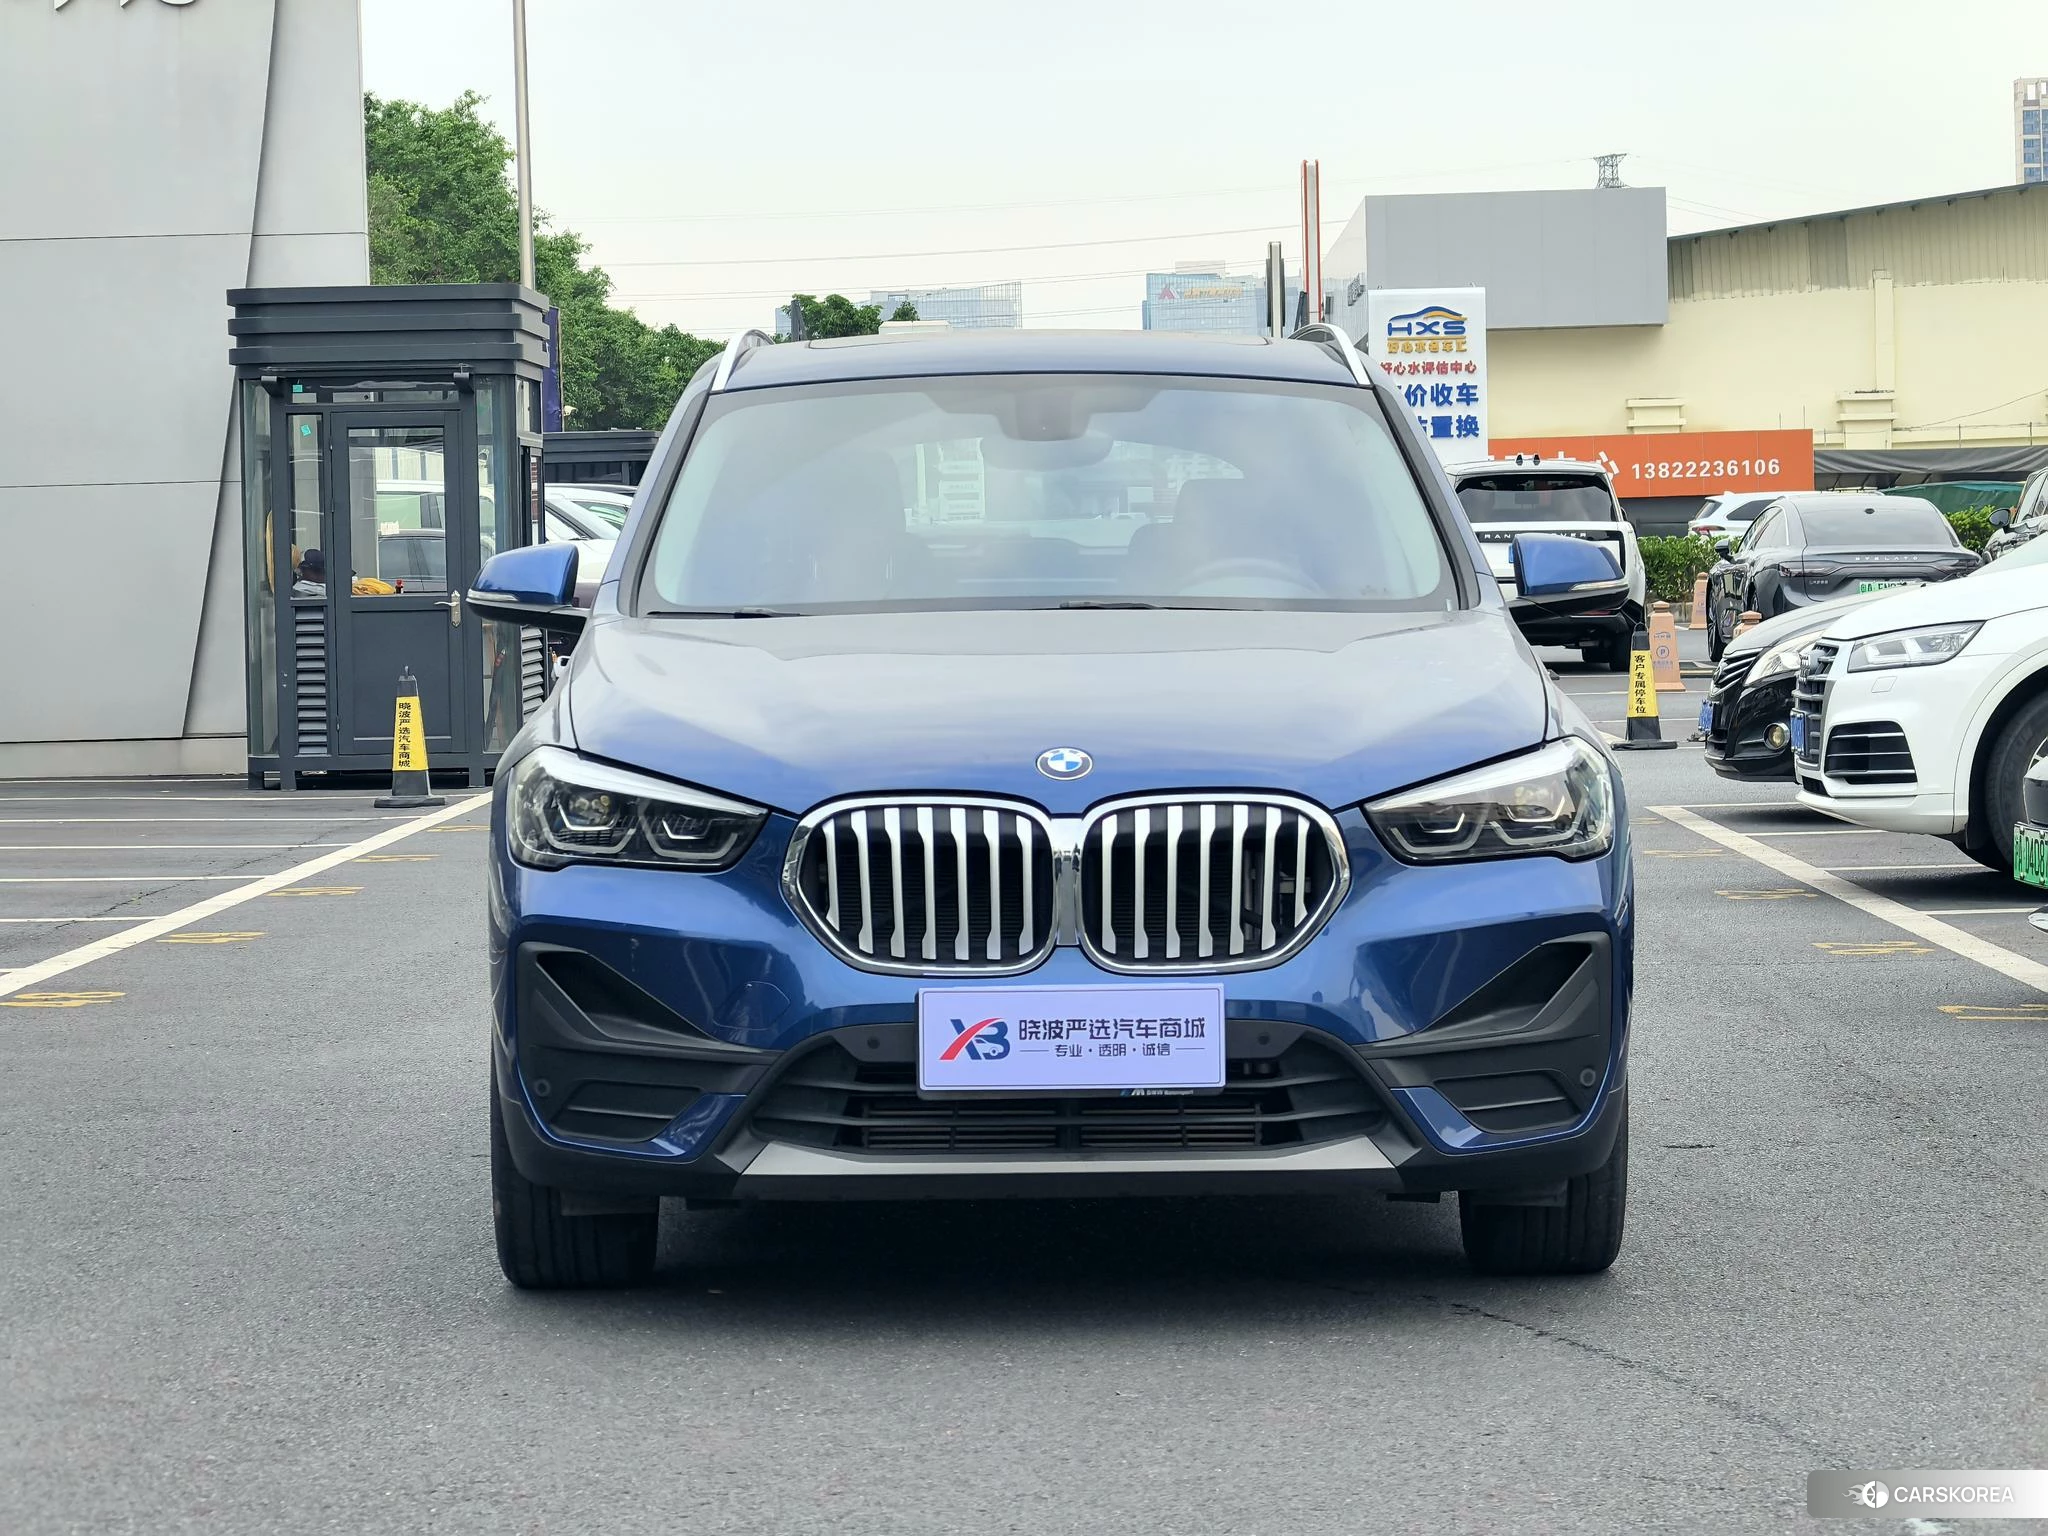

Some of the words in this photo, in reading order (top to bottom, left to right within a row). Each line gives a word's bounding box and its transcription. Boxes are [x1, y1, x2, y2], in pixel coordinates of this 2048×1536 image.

[1387, 320, 1466, 336] HXS
[1397, 383, 1479, 407] 价收车
[1631, 458, 1781, 480] 13822236106
[1634, 654, 1647, 714] 客户专属停车位
[398, 702, 411, 768] 晓波严选汽车商城
[1018, 1017, 1206, 1040] 晓波严选汽车商城
